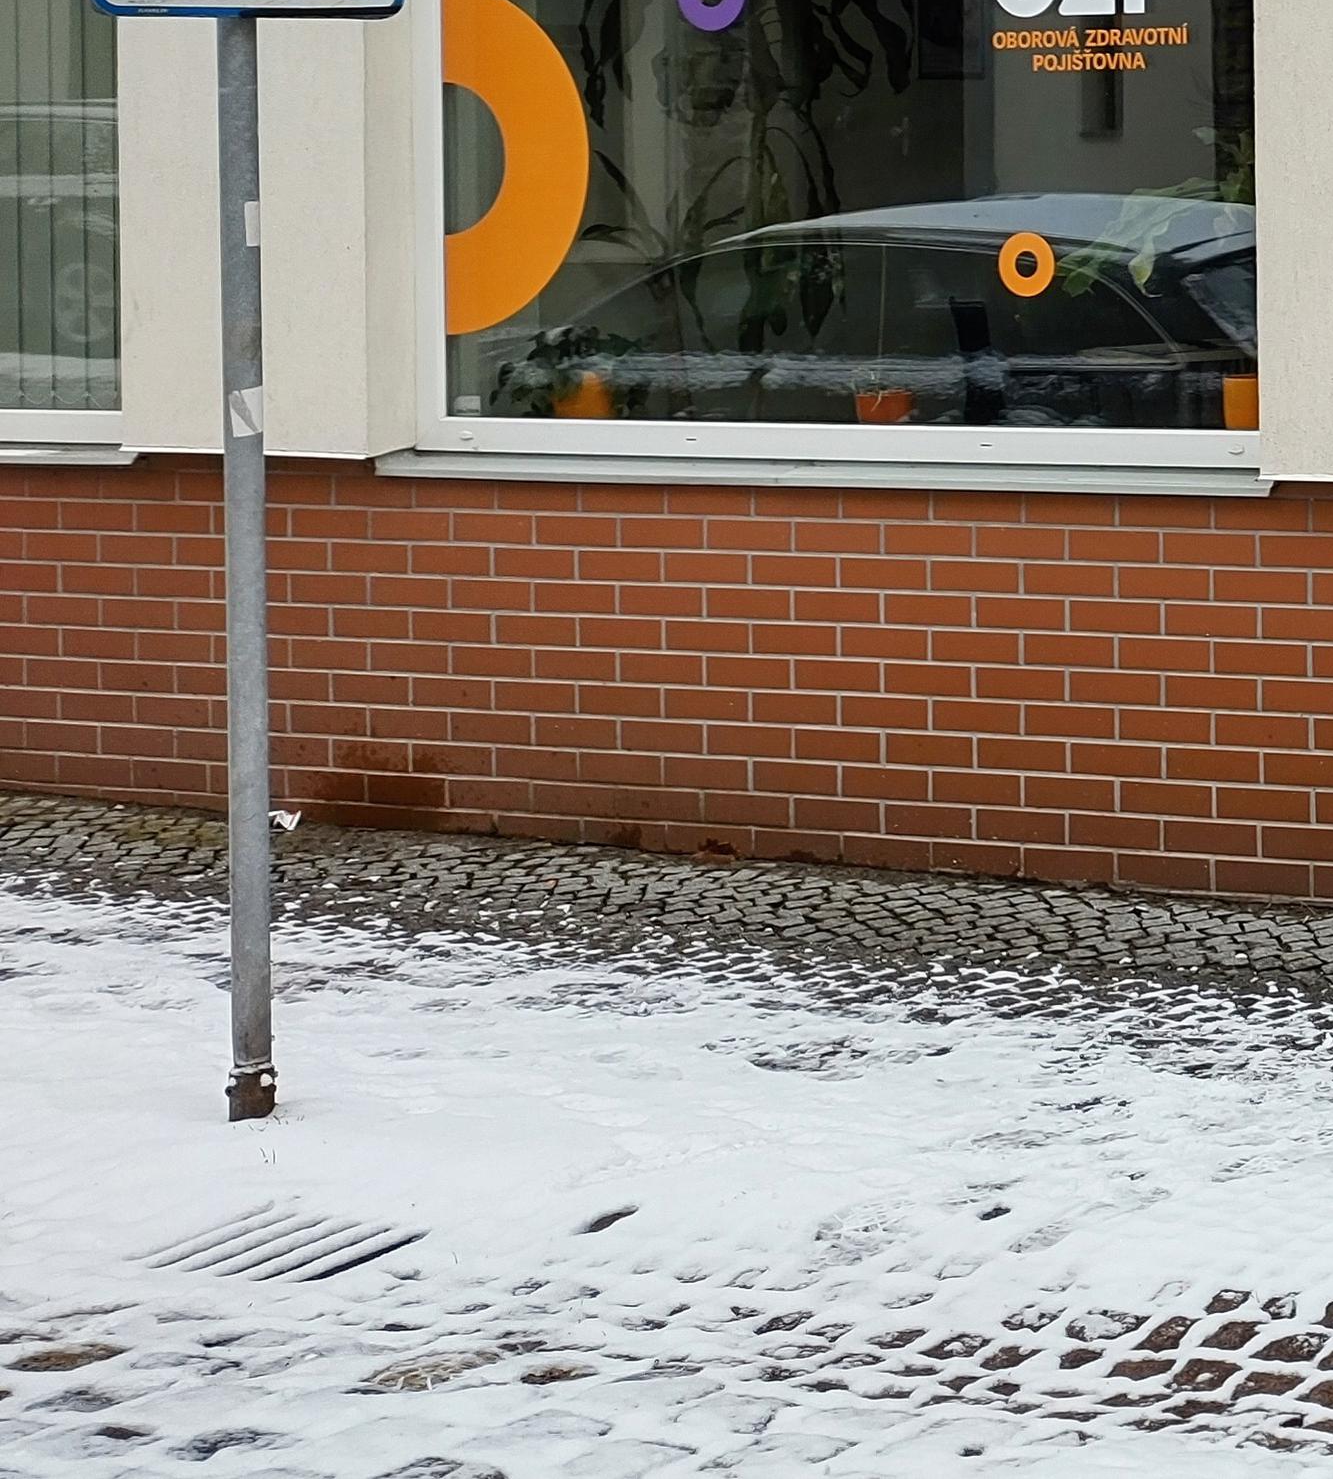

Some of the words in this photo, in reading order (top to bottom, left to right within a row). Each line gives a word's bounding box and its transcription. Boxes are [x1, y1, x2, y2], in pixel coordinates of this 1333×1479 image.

[991, 25, 1080, 50] OBOROVÁ
[1085, 22, 1188, 47] ZDRAVOTNÍ
[1032, 48, 1146, 72] POJIŠŤOVNA
